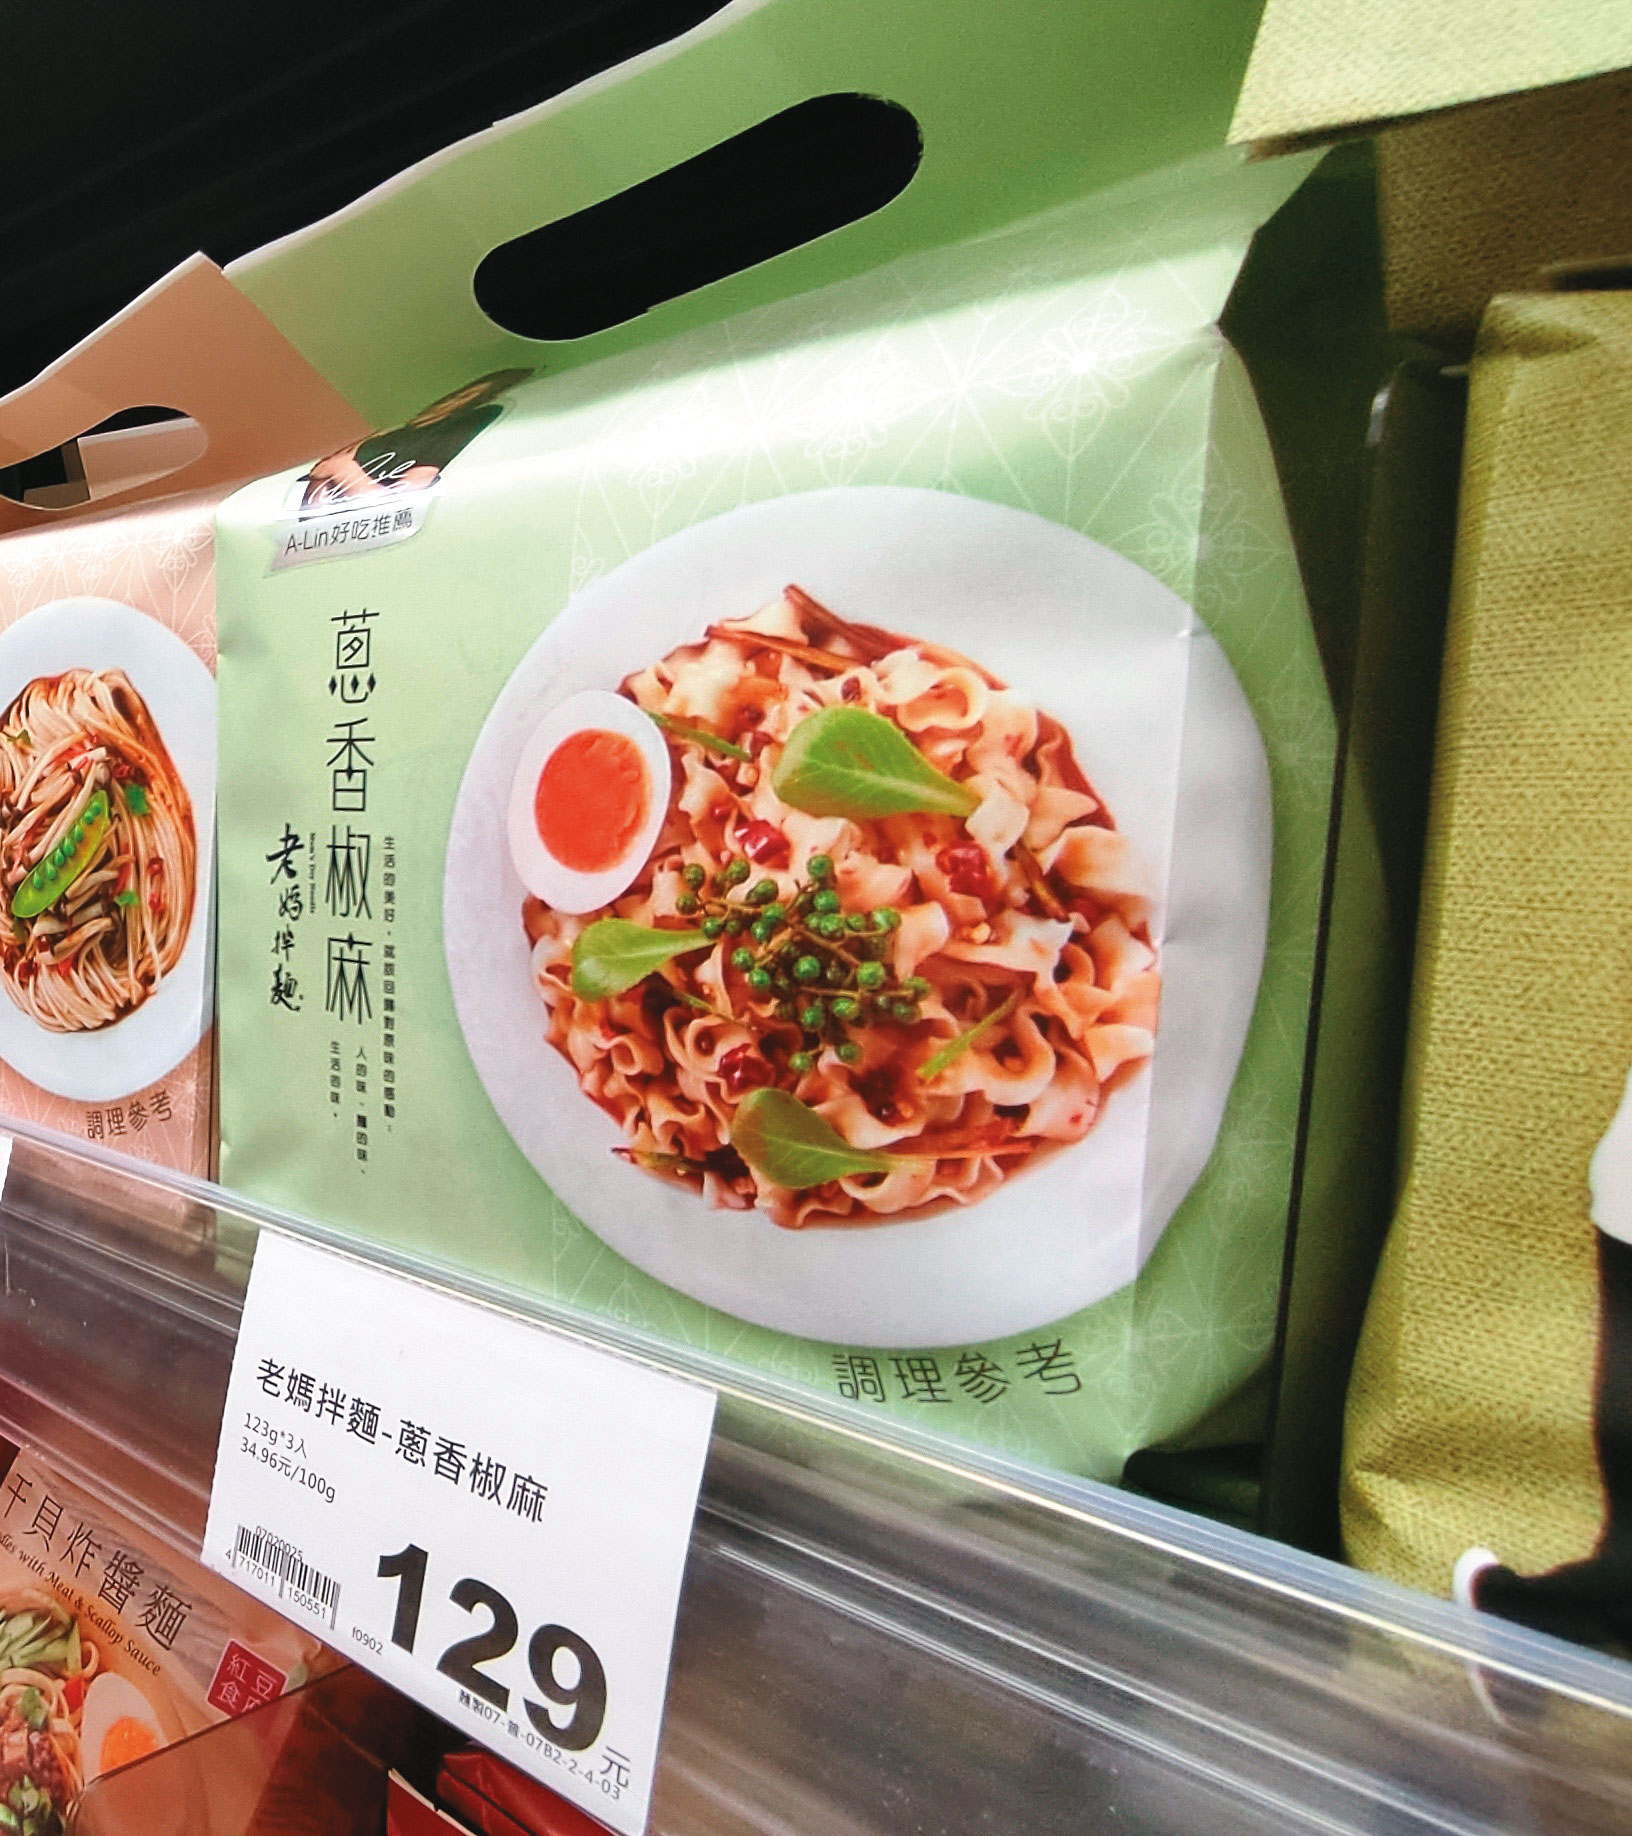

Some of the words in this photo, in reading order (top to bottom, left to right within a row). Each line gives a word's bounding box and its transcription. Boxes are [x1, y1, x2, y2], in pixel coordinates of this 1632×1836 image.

[284, 507, 414, 557] A-Lin好吃推薦
[325, 608, 380, 1025] 蔥香椒麻
[85, 1089, 173, 1139] 調理參考
[831, 1338, 1082, 1403] 調理參考
[239, 1436, 337, 1504] 34.96元/100g
[255, 1357, 549, 1523] 老媽拌麵-蔥香椒麻
[4, 1473, 193, 1651] 干貝炸醬麵
[239, 1555, 276, 1588] 717011
[287, 1586, 327, 1619] 150551
[19, 1549, 49, 1578] with
[45, 1570, 76, 1603] Meat
[74, 1597, 84, 1611] &
[86, 1604, 125, 1645] Scallop
[124, 1639, 162, 1676] Sauce
[226, 1653, 278, 1701] 紅豆
[377, 1544, 608, 1752] 129
[599, 1745, 631, 1789] 元
